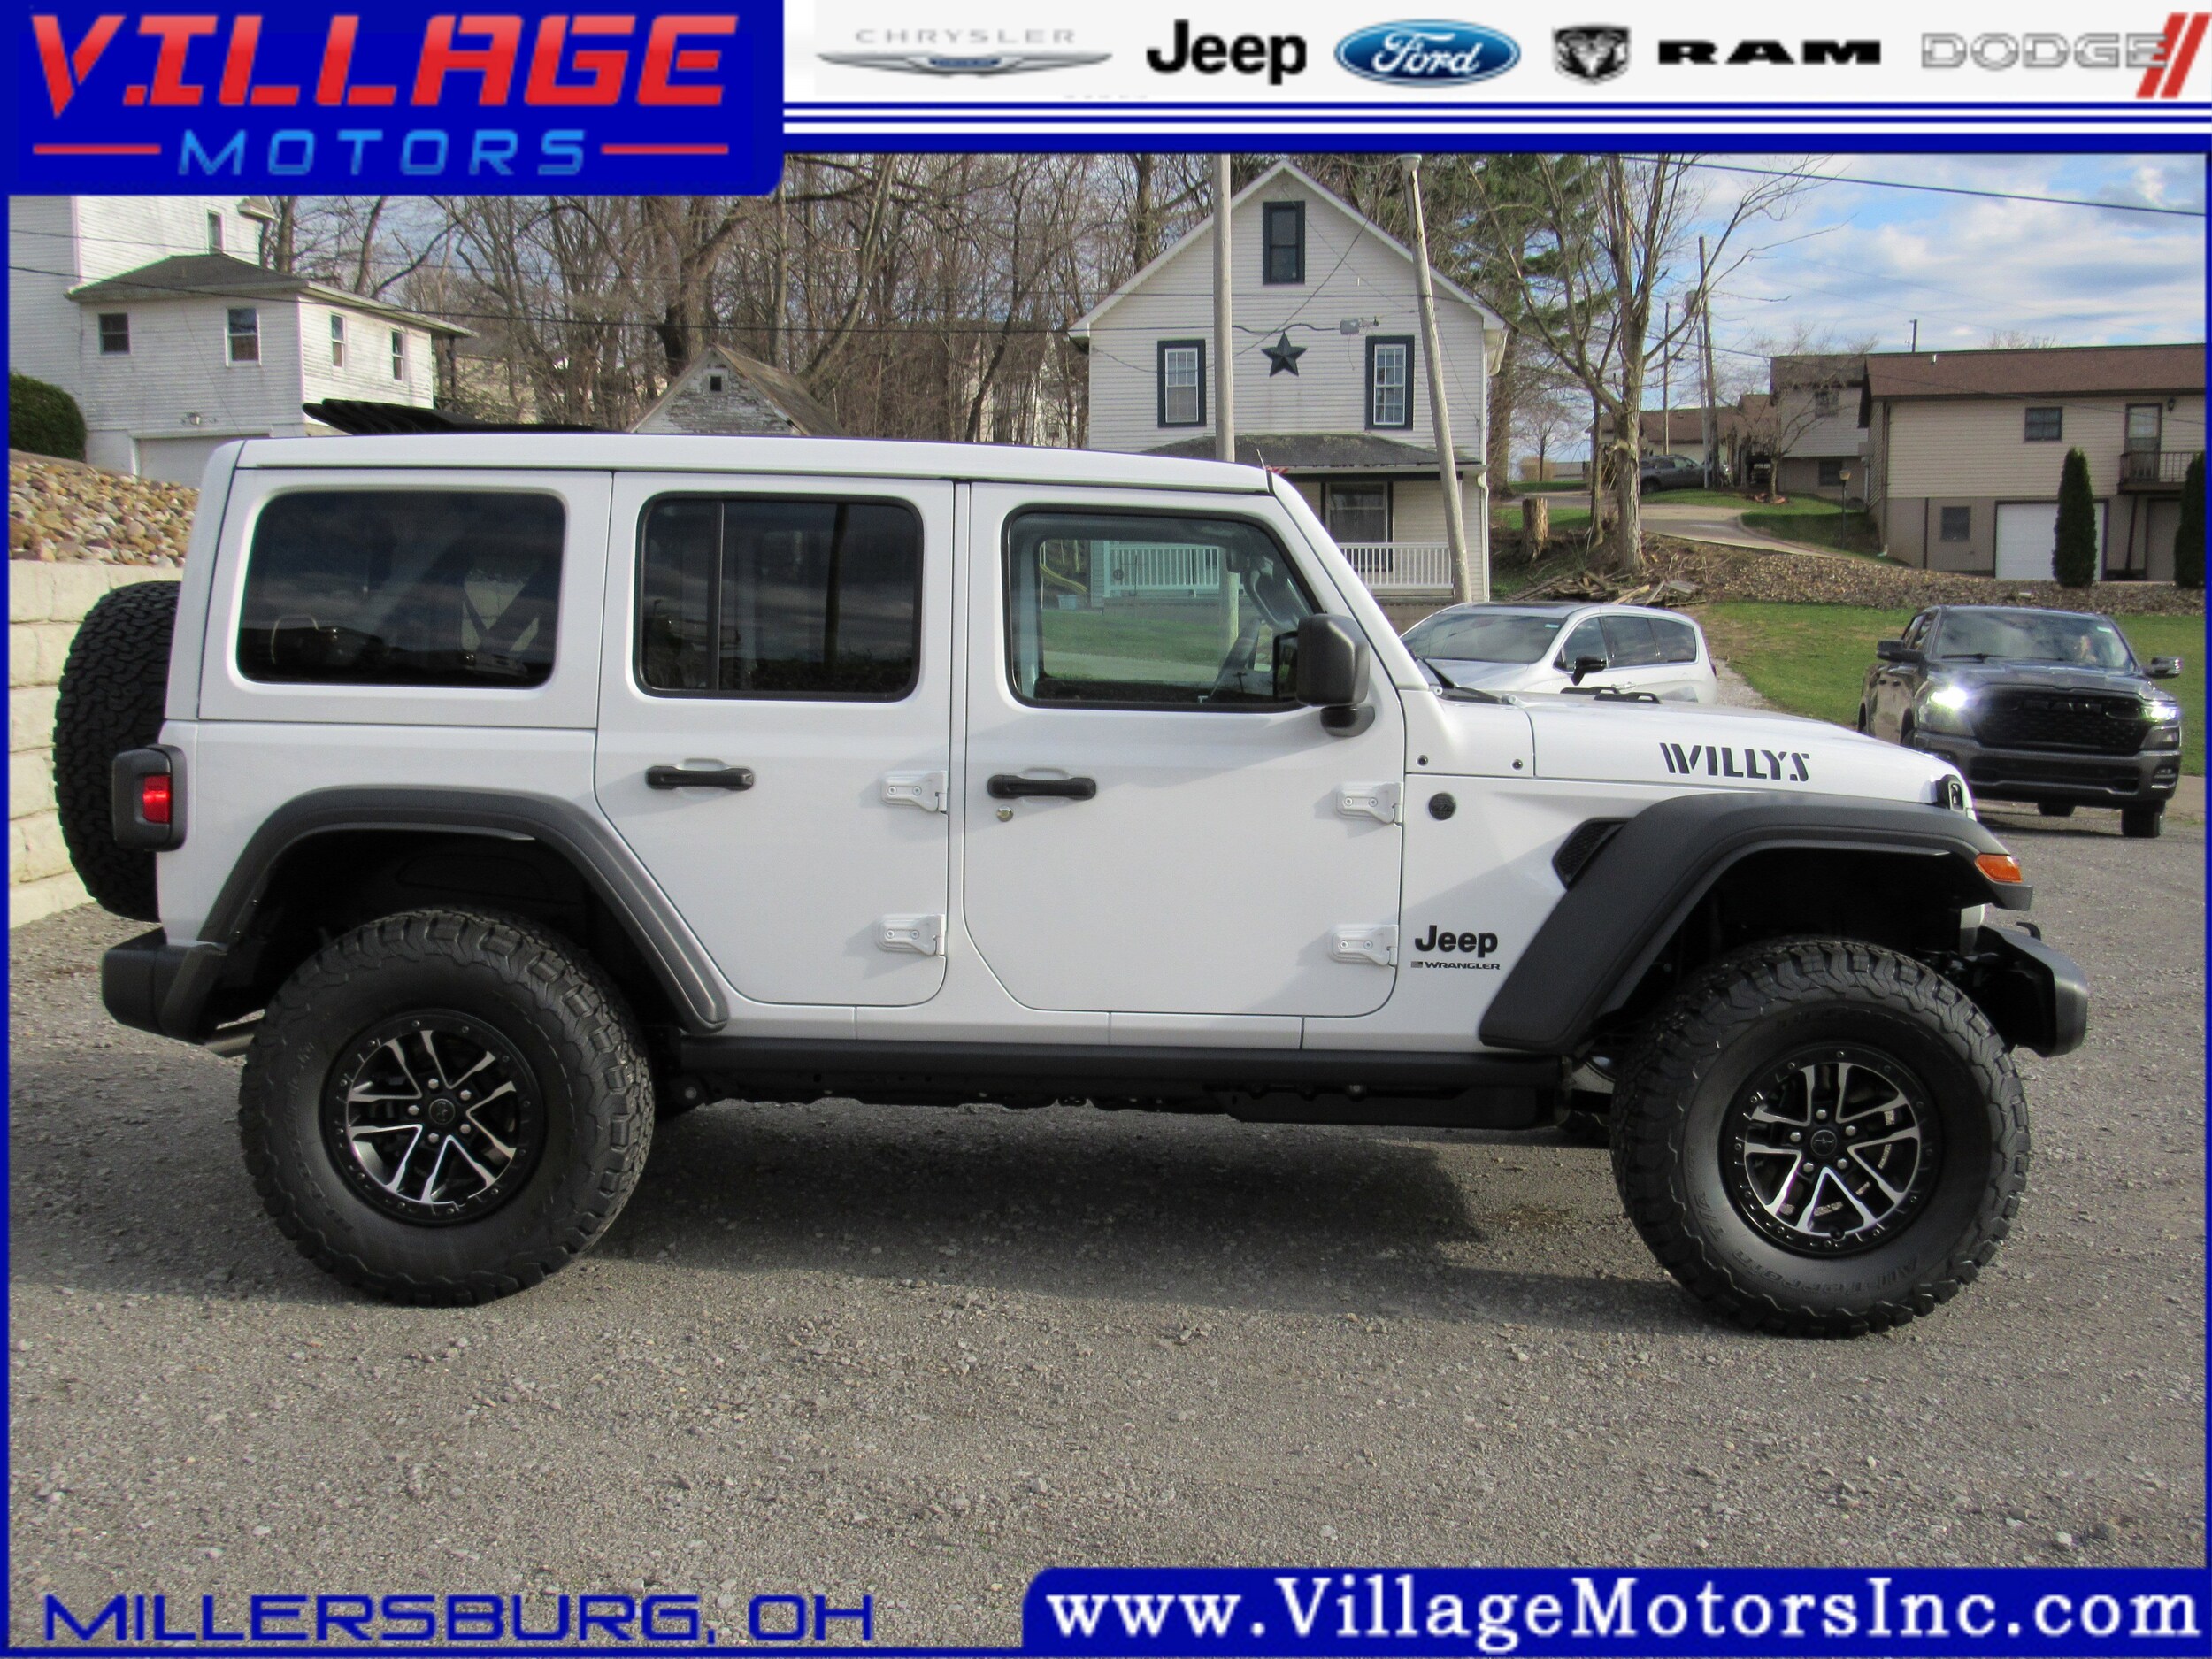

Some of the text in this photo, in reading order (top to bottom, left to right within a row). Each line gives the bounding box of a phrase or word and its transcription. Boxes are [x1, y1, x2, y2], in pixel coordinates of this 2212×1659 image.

[1659, 742, 1809, 782] WILLYS
[1414, 925, 1499, 958] Jeep
[1424, 961, 1501, 971] WRANGLER
